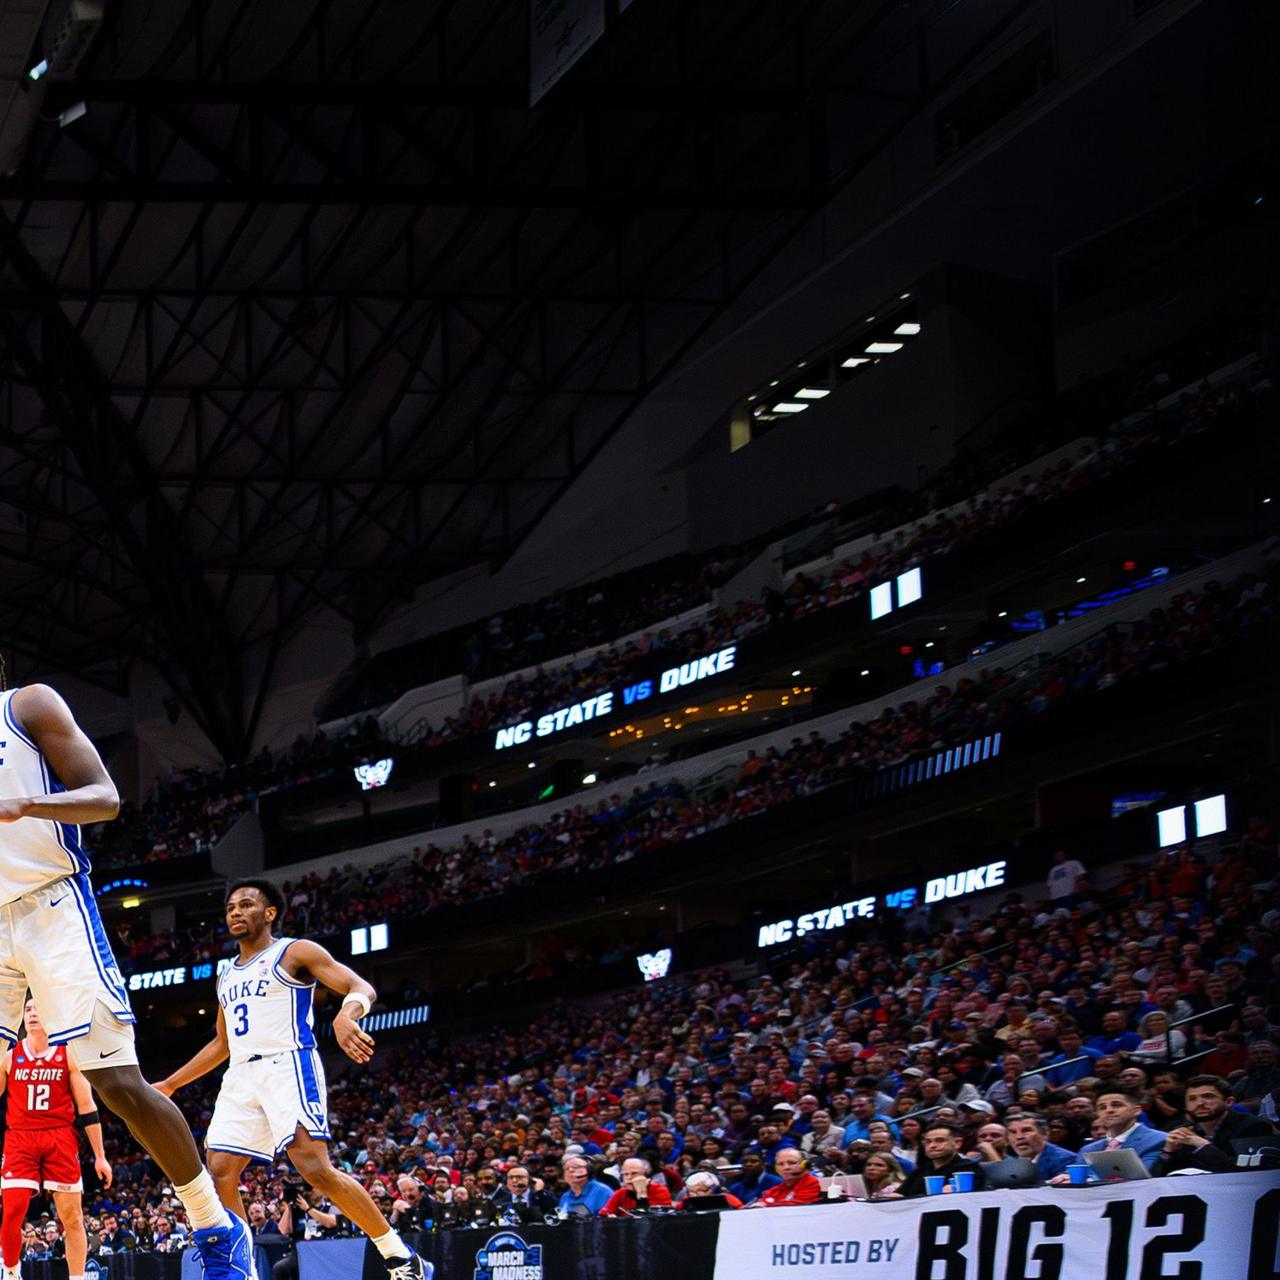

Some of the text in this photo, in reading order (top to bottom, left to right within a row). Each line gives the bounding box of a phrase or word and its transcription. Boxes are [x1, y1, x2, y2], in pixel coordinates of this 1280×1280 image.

[495, 646, 737, 750] NC STATE VS DUKE
[758, 860, 1007, 947] NC STATE VS DUKE
[128, 967, 187, 991] STATE
[192, 964, 213, 981] VS
[219, 980, 270, 1010] DUKE
[233, 1003, 249, 1037] 3
[14, 1069, 63, 1080] NC STATE
[26, 1084, 51, 1111] 12
[487, 1251, 524, 1267] MARCH
[771, 1241, 859, 1266] HOSTED
[866, 1238, 900, 1263] BY
[492, 1266, 541, 1280] MADNESS
